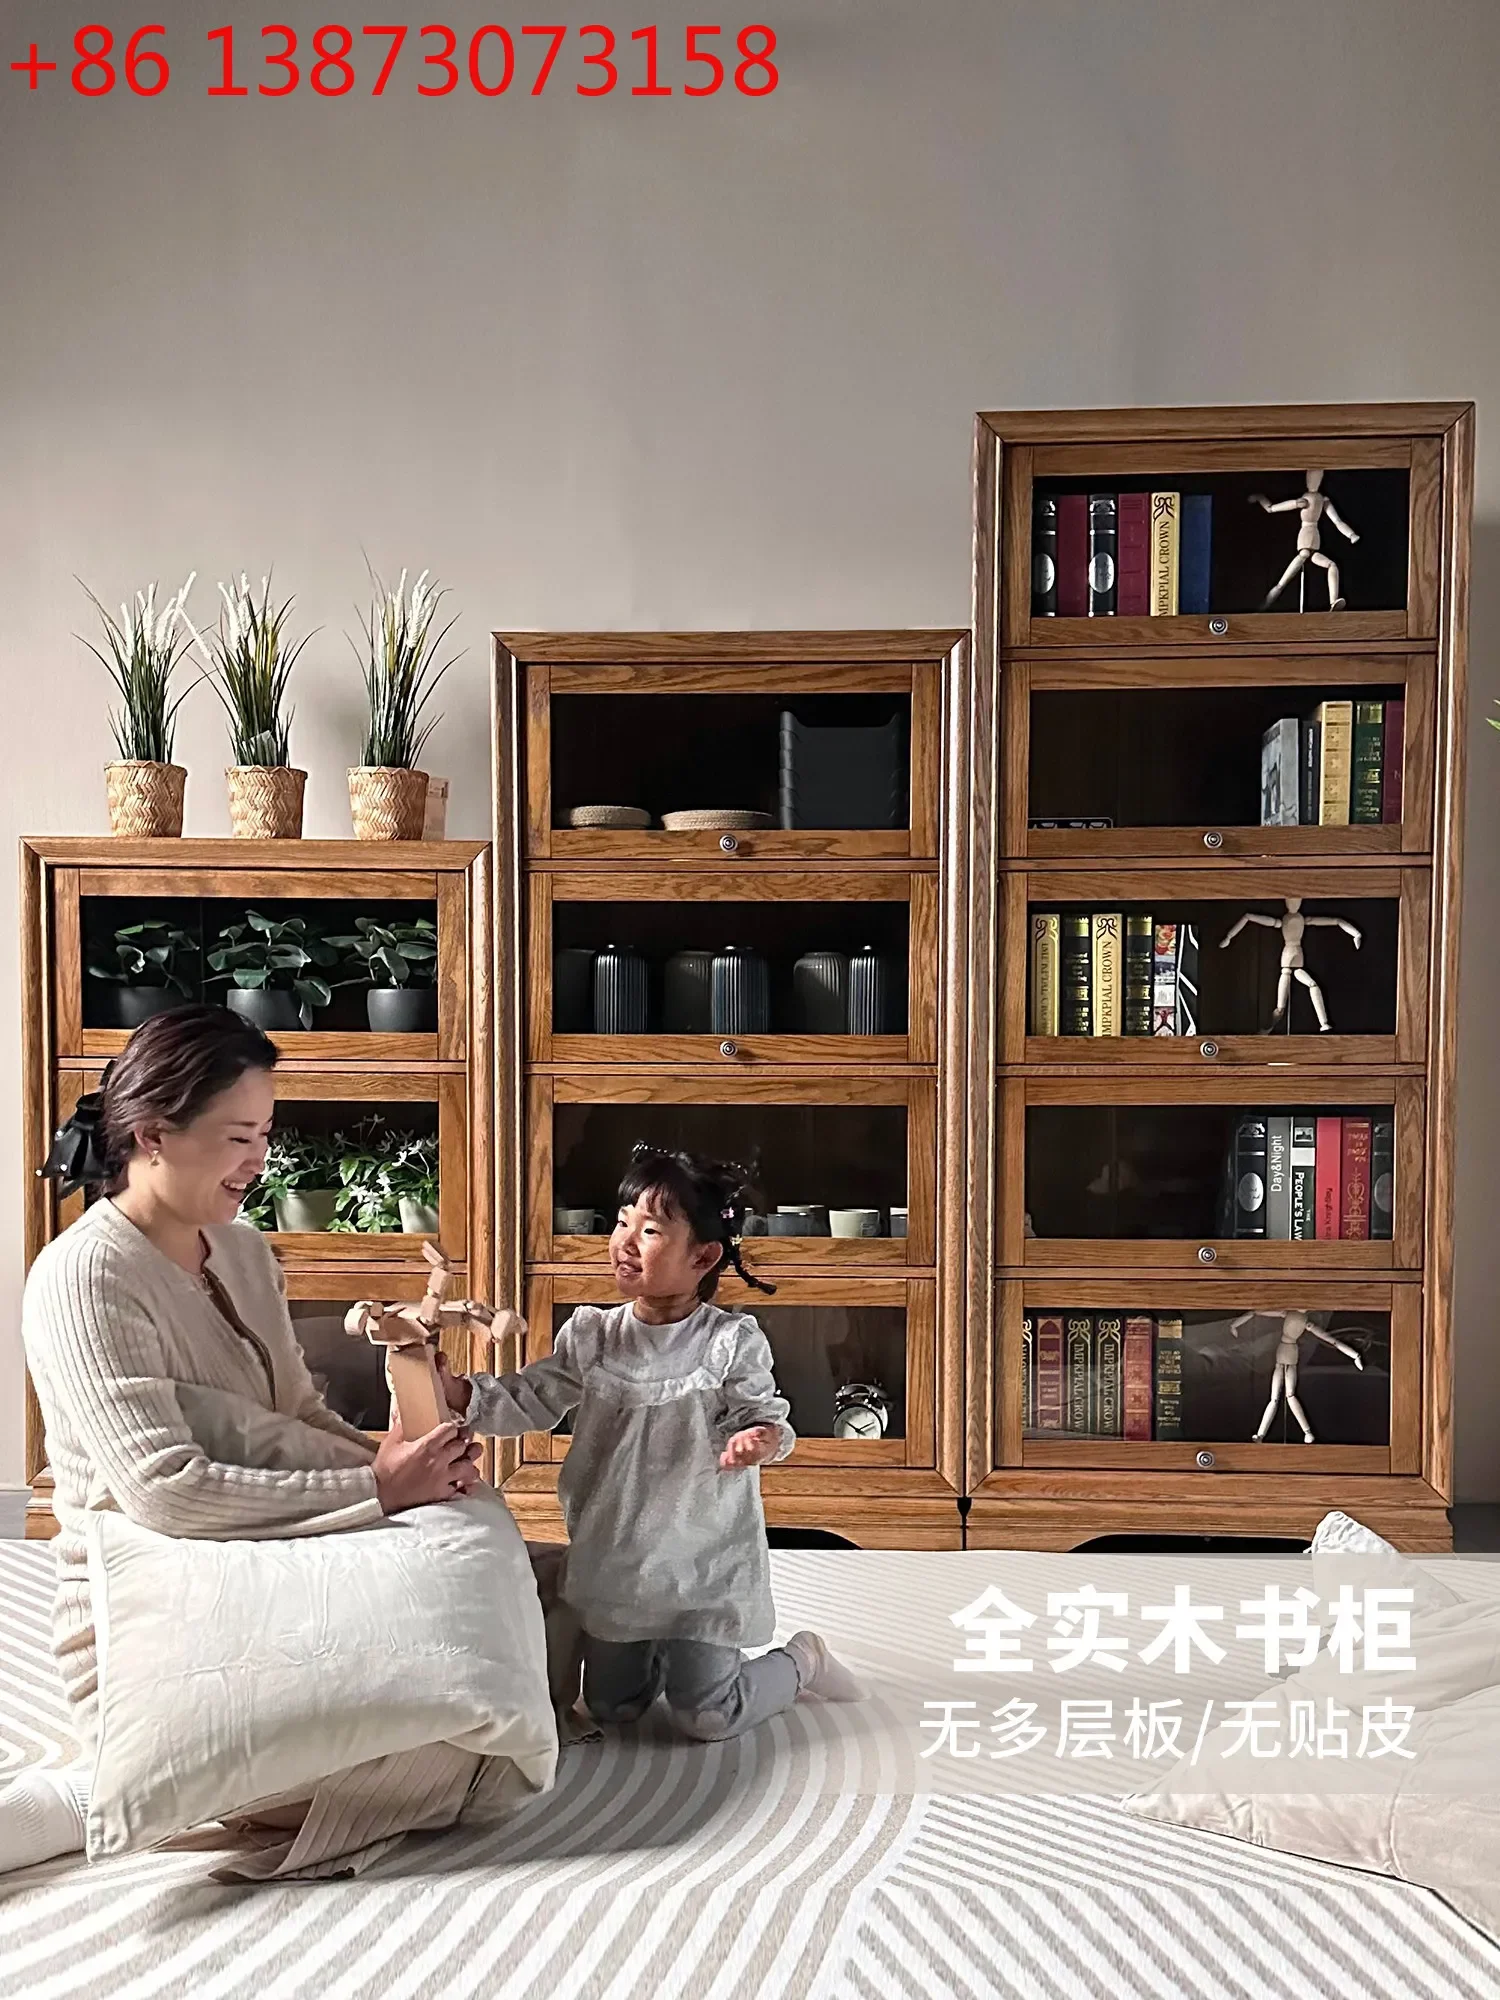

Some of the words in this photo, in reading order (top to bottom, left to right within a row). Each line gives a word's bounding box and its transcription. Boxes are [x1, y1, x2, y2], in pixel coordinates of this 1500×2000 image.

[1159, 521, 1170, 564] CROWN
[1102, 942, 1112, 983] CROWN
[1102, 984, 1112, 1036] IMPKPIAL
[1270, 1135, 1285, 1192] Day&Night
[1294, 1219, 1304, 1240] LAW
[1074, 1344, 1084, 1395] IMPKPIAL
[1104, 1344, 1114, 1395] IMPKPIAL
